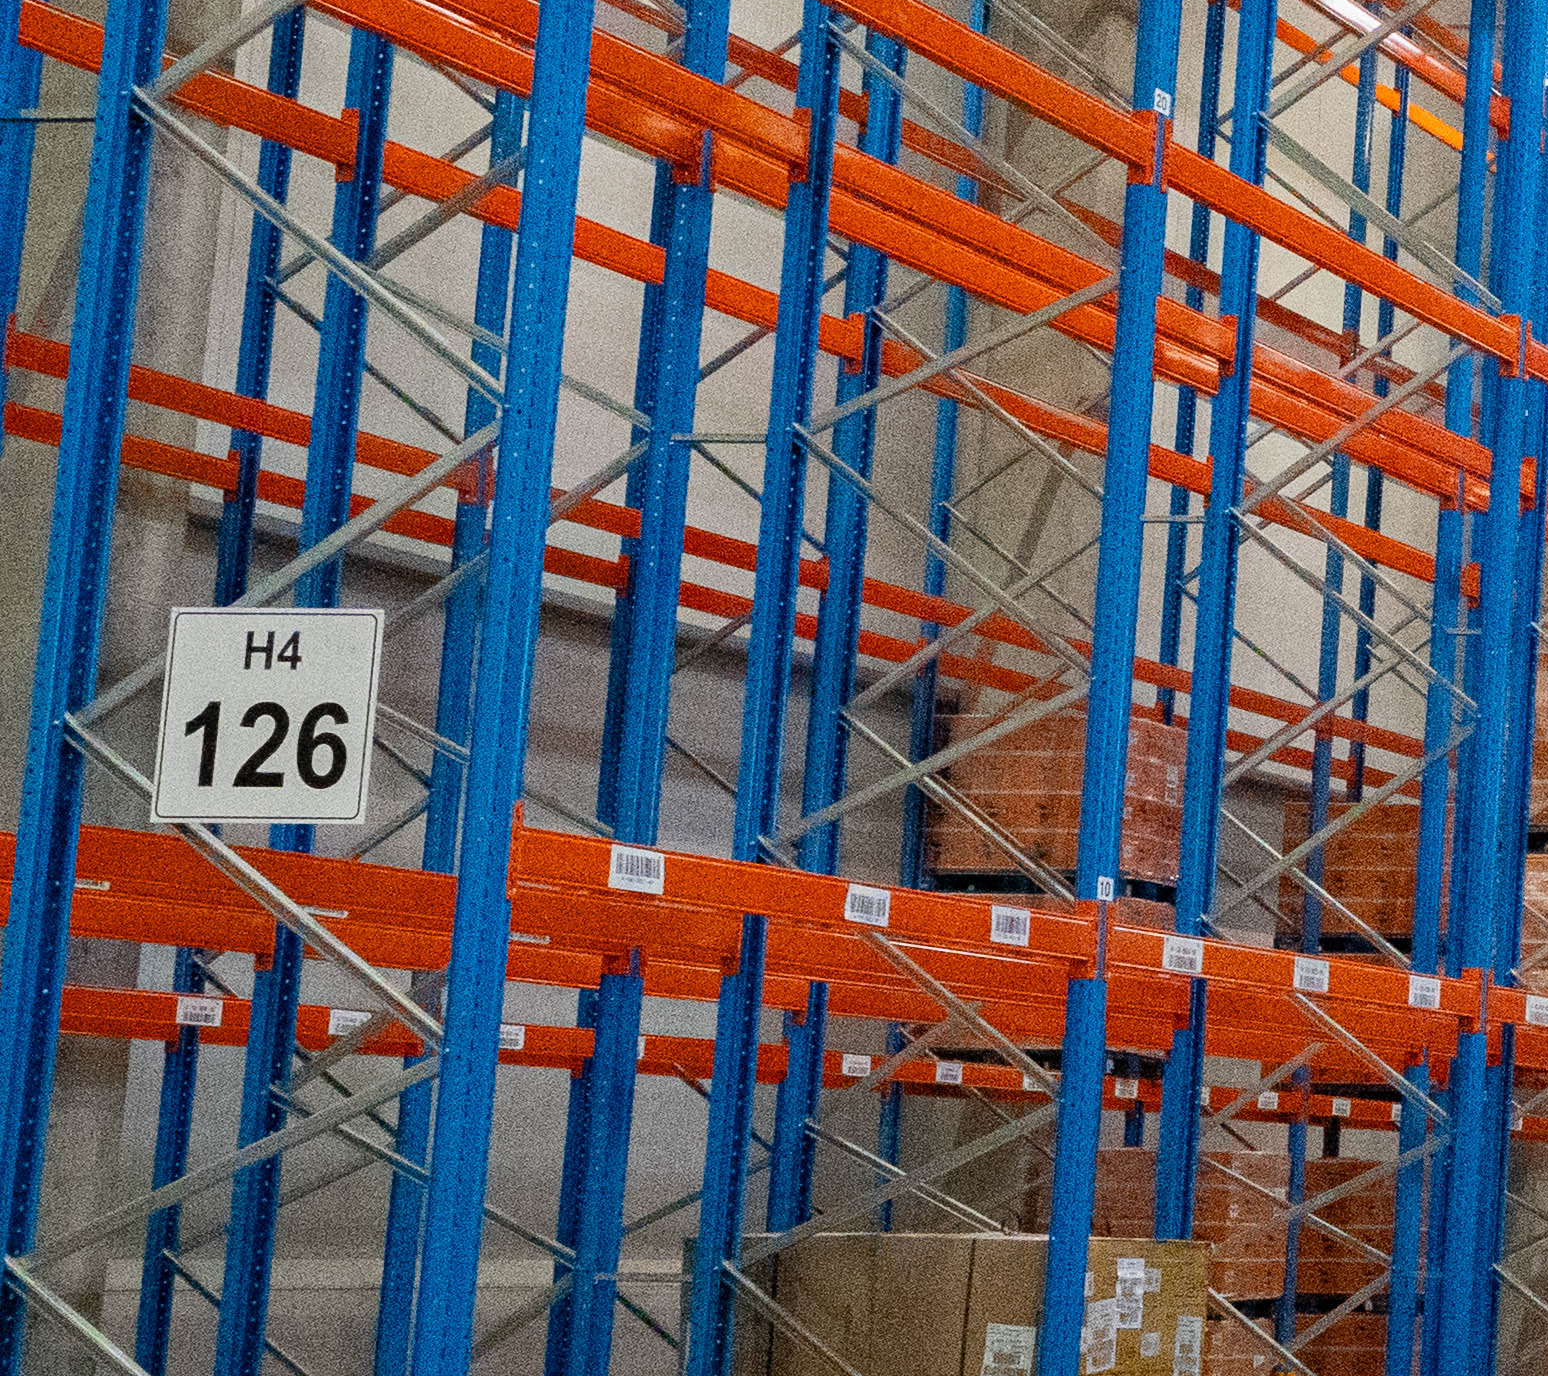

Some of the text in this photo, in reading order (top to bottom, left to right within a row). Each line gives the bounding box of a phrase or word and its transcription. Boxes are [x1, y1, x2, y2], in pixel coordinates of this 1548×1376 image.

[244, 631, 301, 670] H4
[185, 702, 348, 789] 126
[1100, 882, 1111, 894] 10
